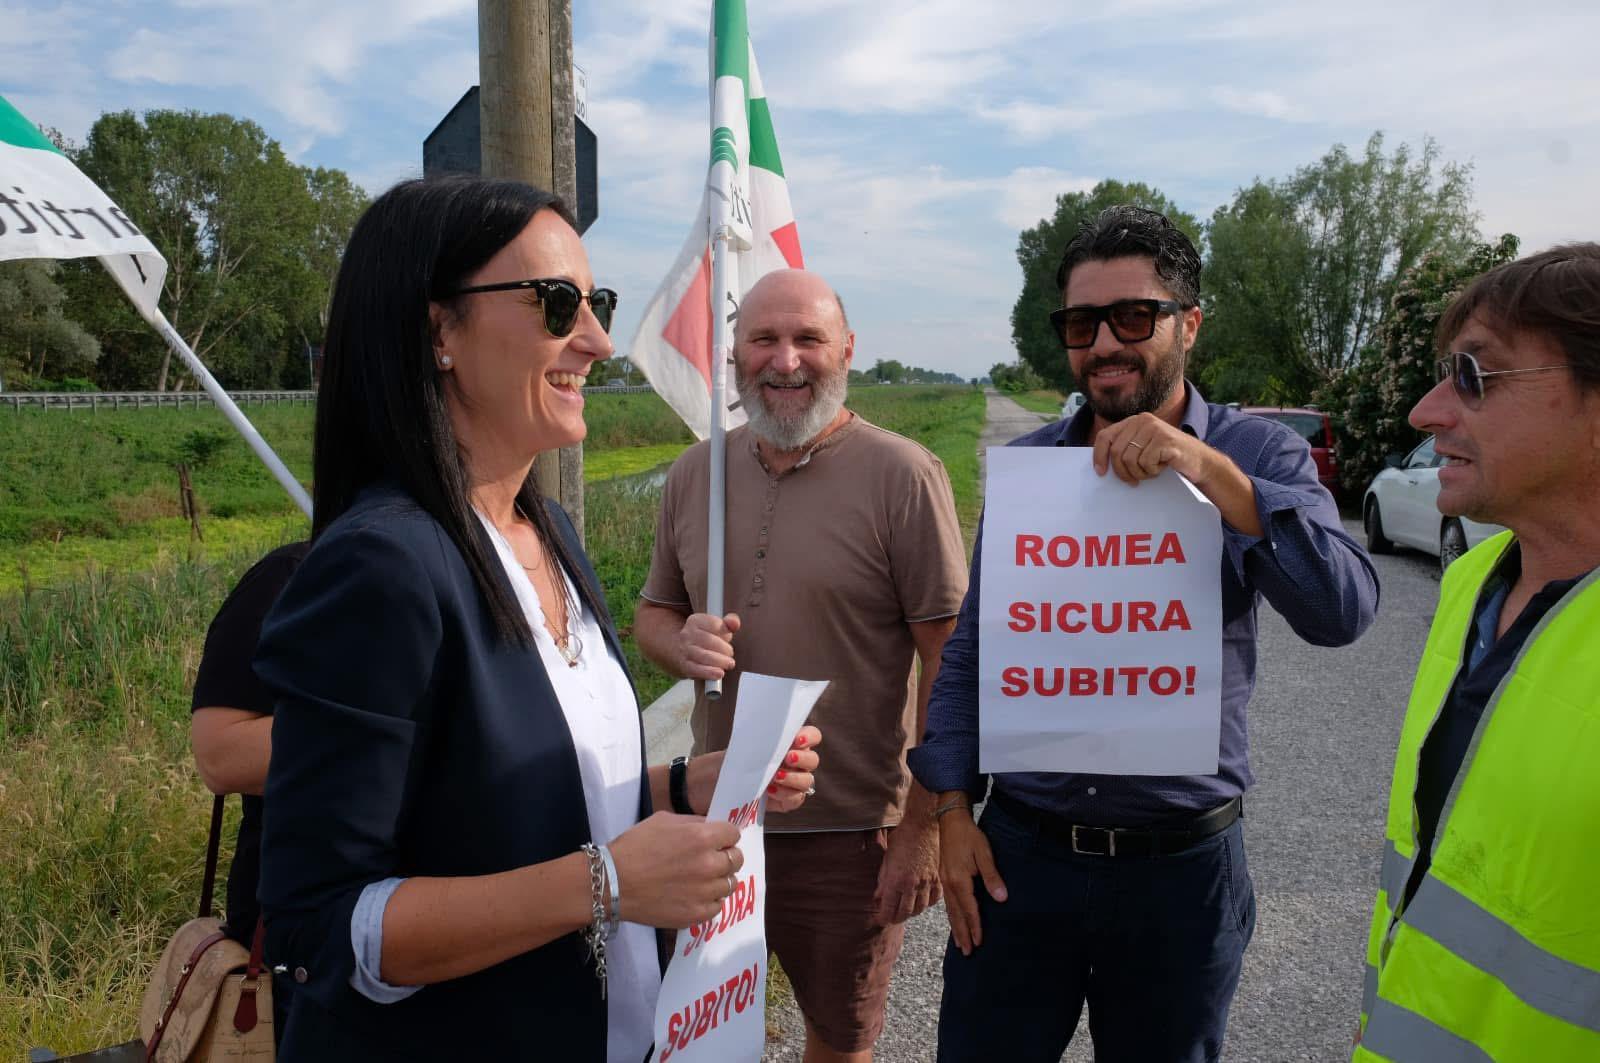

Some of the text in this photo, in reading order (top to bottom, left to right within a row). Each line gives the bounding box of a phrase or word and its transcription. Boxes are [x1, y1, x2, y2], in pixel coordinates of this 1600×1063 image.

[1015, 532, 1186, 568] ROMEA
[1007, 599, 1192, 634] SICURA
[1001, 665, 1196, 697] SUBITO!
[659, 962, 758, 1063] SUBITO!
